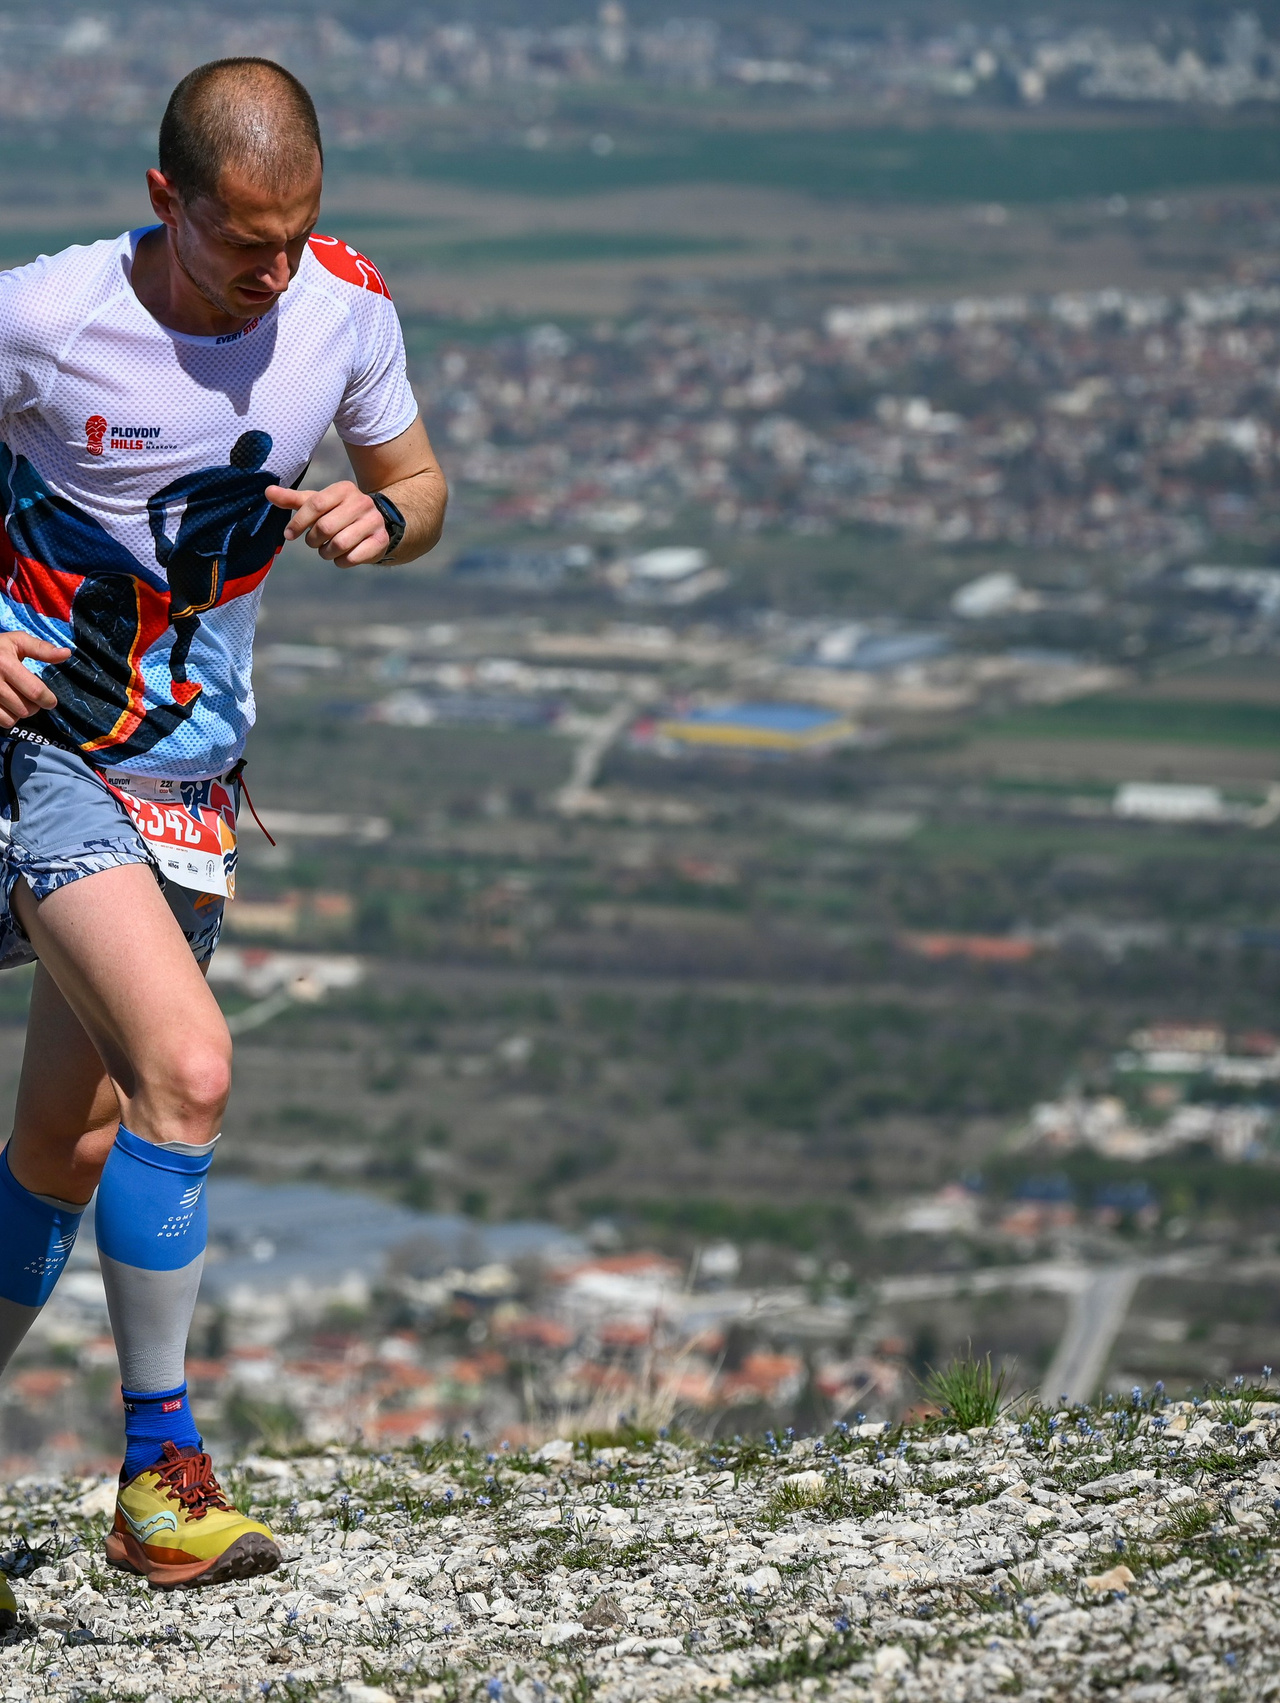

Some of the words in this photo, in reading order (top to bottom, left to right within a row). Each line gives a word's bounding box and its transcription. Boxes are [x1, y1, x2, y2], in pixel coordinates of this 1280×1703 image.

[216, 331, 243, 345] EVERY
[111, 427, 161, 438] PLOVDIV
[111, 439, 143, 450] HILLS
[120, 790, 202, 845] 2342
